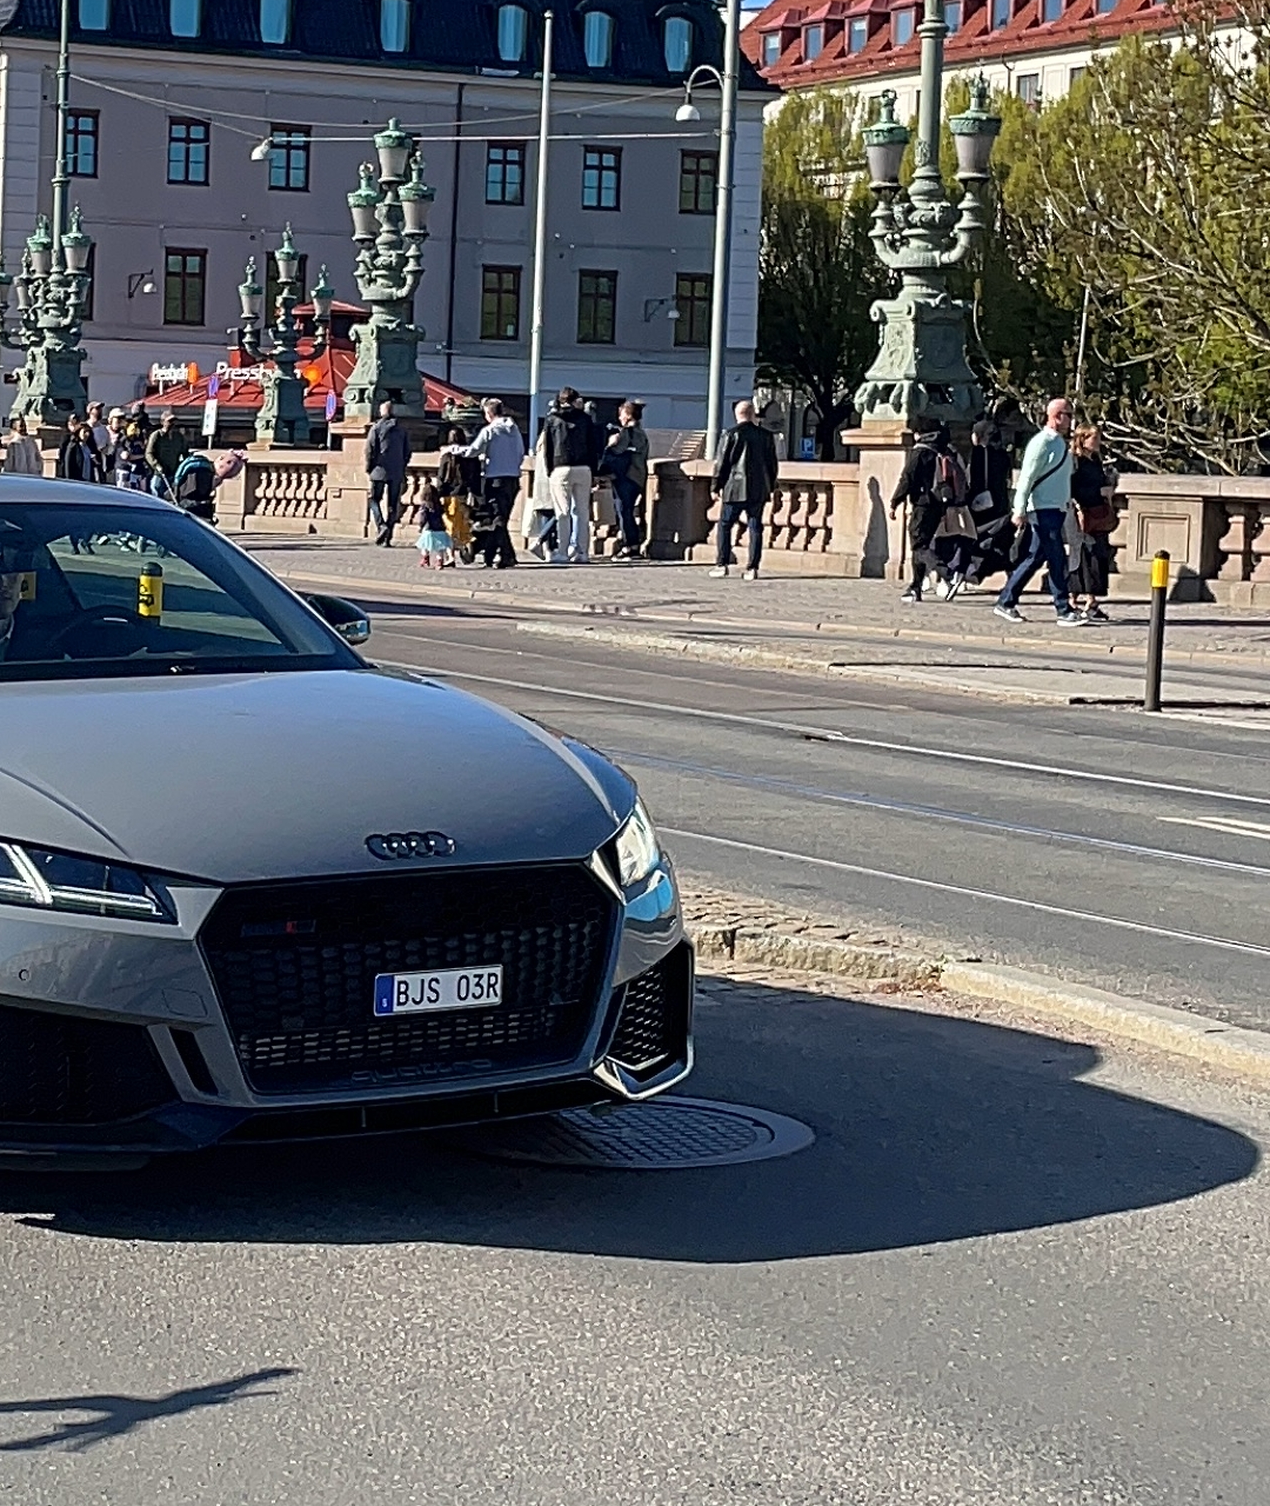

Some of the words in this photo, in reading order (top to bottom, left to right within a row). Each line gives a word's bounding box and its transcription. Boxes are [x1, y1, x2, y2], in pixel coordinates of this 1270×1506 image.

[803, 438, 813, 452] P
[396, 977, 440, 1006] BJS
[457, 972, 499, 1001] 03R
